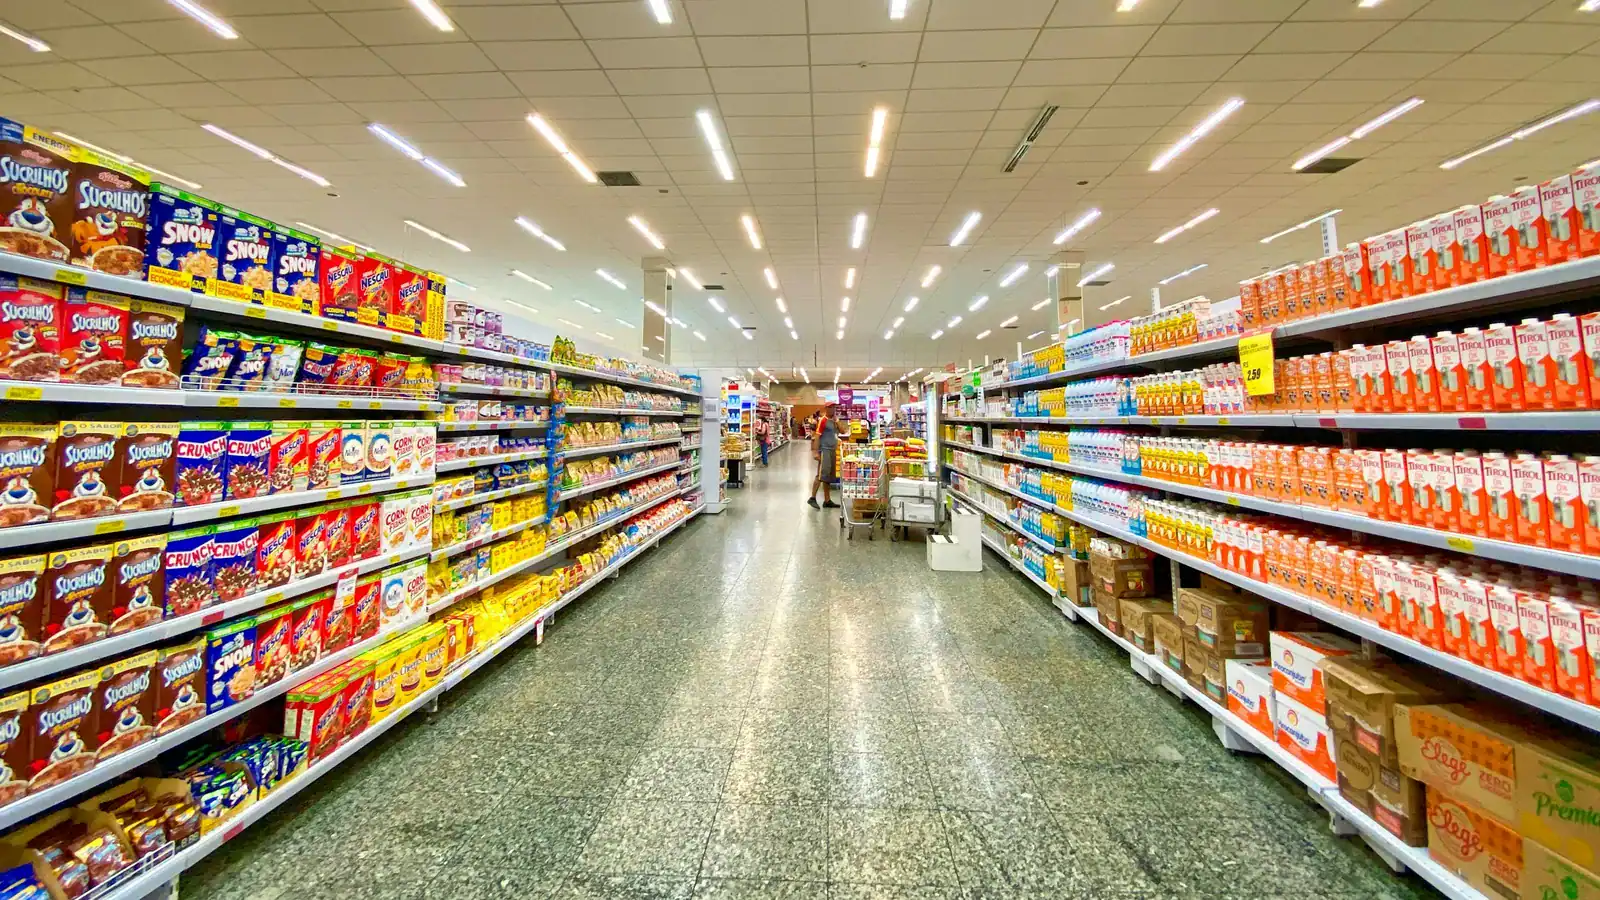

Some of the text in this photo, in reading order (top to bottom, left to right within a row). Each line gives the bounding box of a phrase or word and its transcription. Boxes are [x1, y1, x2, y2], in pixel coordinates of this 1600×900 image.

[0, 156, 69, 194] SUCRILHOS
[78, 180, 147, 218] SUCRILHOS
[1542, 186, 1570, 201] TIROL
[1485, 207, 1511, 219] TIROL
[1511, 197, 1538, 211] TIROL
[1431, 224, 1454, 236] TIROL
[1456, 215, 1480, 228] TIROL
[161, 221, 215, 245] SNOW
[226, 240, 270, 261] SNOW
[279, 255, 316, 275] SNOW
[328, 263, 353, 284] NESCAU
[361, 268, 390, 290] NESCAU
[398, 279, 425, 302] NESCAU
[2, 302, 54, 323] SUCRILHOS
[72, 314, 121, 333] SUCRILHOS
[132, 321, 178, 341] SUCRILHOS
[1486, 338, 1513, 348] TIROL
[1518, 333, 1546, 344] TIROL
[1548, 329, 1577, 340] TIROL
[1411, 347, 1429, 357] TIROL
[1434, 345, 1457, 354] TIROL
[1460, 341, 1483, 351] TIROL
[194, 355, 233, 372] SNOW
[304, 361, 334, 376] CRUNC
[129, 440, 173, 465] SUCRILHOS
[178, 437, 227, 457] CRUNCH
[228, 436, 272, 455] CRUNCH
[394, 435, 412, 451] CORN
[417, 435, 434, 450] CORN
[0, 445, 47, 467] UCRILHOS
[65, 440, 116, 467] SUCRILHOS
[1363, 459, 1380, 469] TIROL
[1384, 460, 1404, 469] TIROL
[1408, 462, 1429, 472] TIROL
[1429, 462, 1453, 474] TIROL
[1455, 466, 1480, 475] TIROL
[1485, 467, 1509, 478] TIROL
[1513, 469, 1542, 480] TIROL
[1546, 470, 1577, 482] TIROL
[354, 508, 377, 533] NESCAU
[214, 533, 259, 557] CRUNCH
[260, 526, 293, 561] NESCAU
[300, 520, 326, 551] NESCAU
[166, 541, 216, 568] CRUNCH
[120, 553, 161, 585] SUCRILHOS
[55, 564, 106, 600] SUCRILHOS
[293, 611, 318, 642] NESCAU
[259, 620, 289, 660] NESCAU
[163, 652, 202, 688] SUCRILHOS
[213, 643, 255, 681] SNOW
[105, 671, 150, 711] SUCRILHOS
[40, 692, 93, 736] SUCRILHOS
